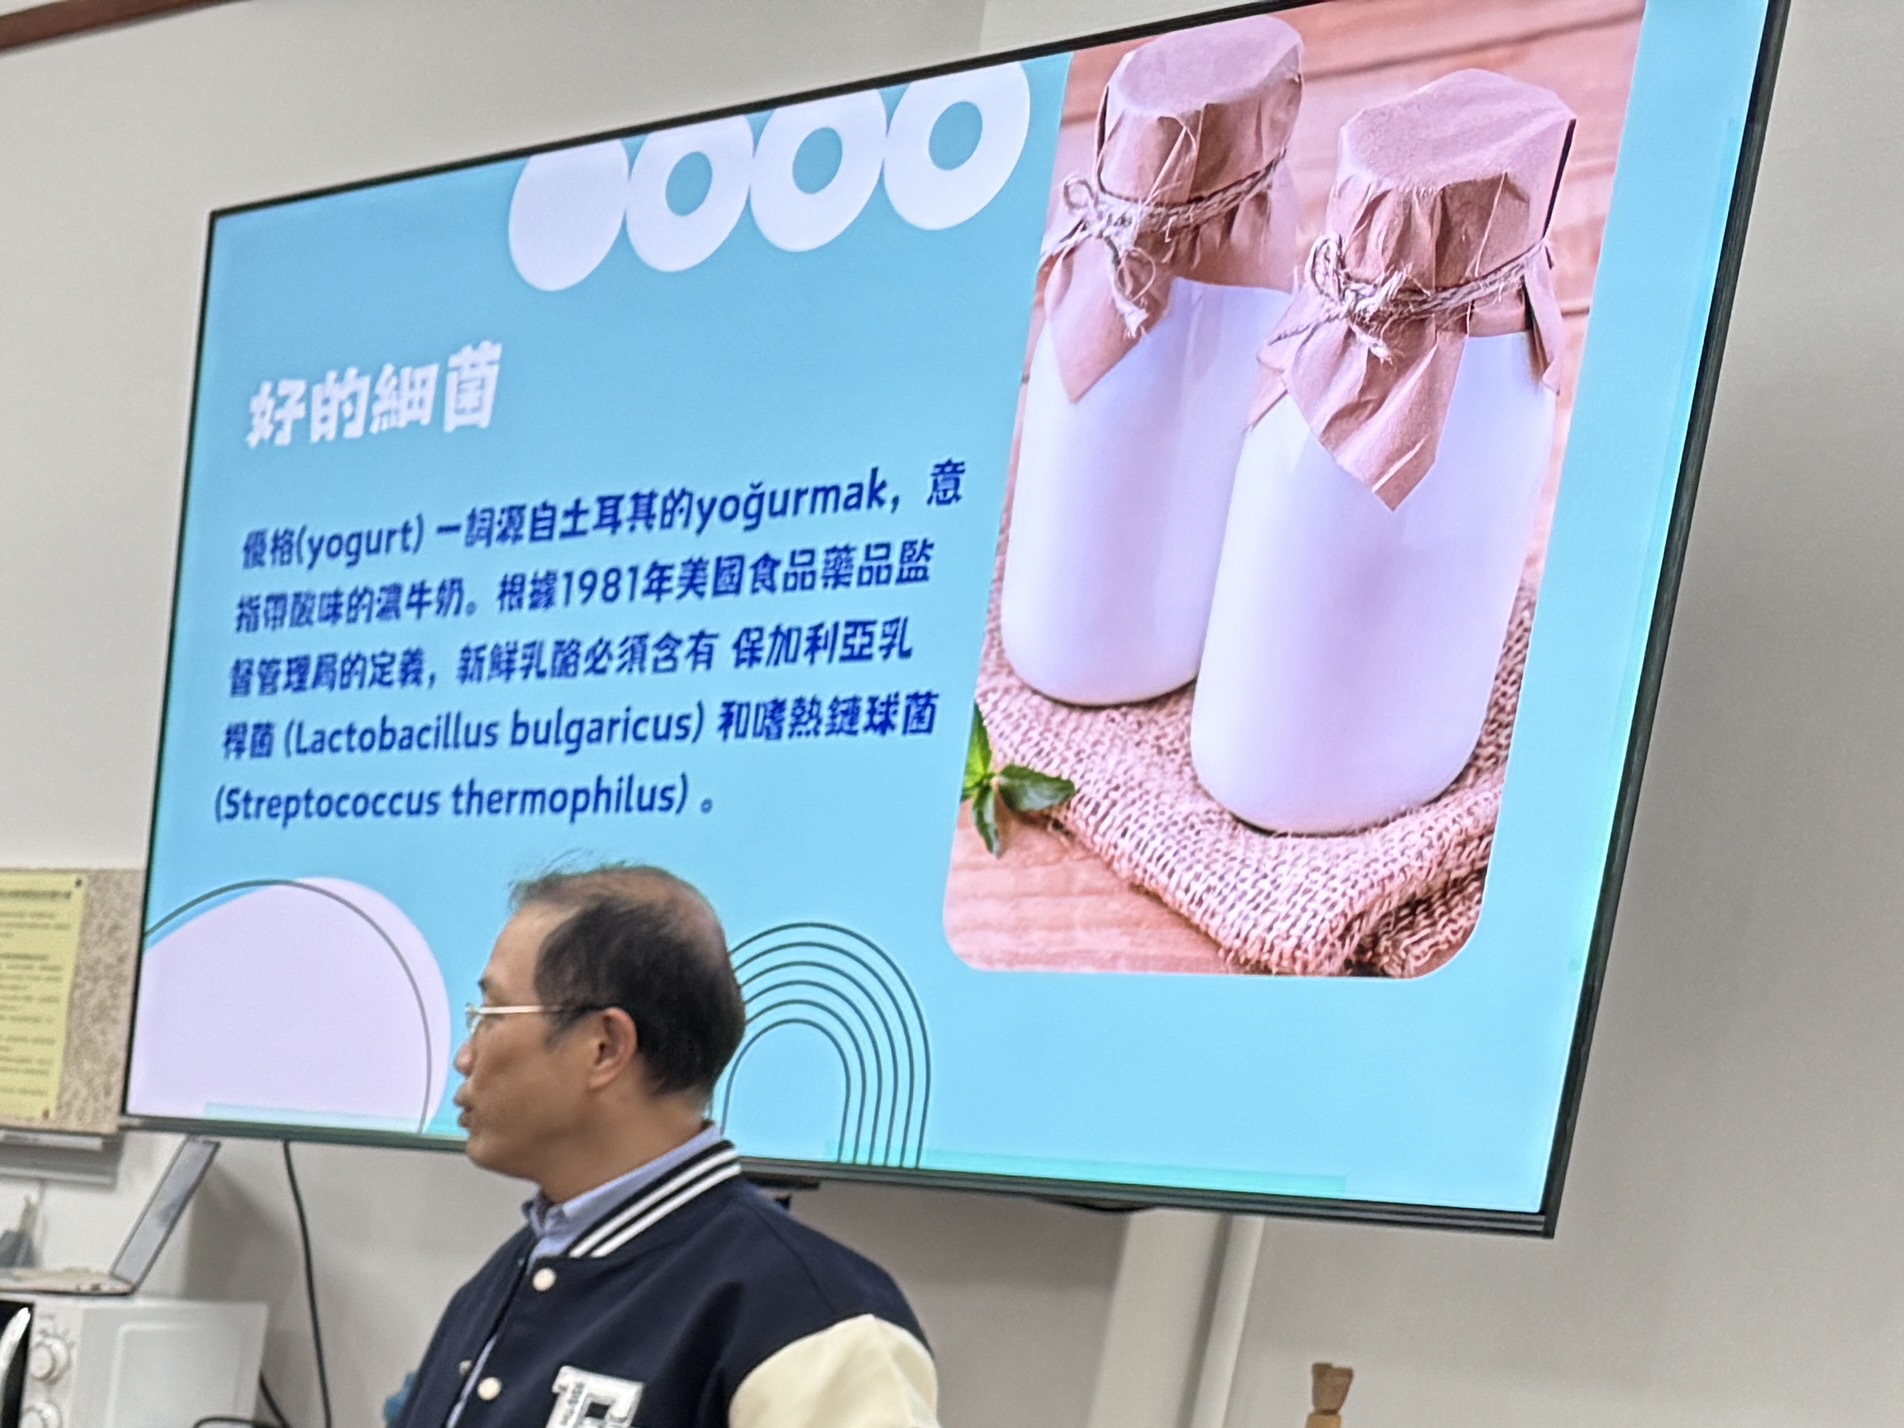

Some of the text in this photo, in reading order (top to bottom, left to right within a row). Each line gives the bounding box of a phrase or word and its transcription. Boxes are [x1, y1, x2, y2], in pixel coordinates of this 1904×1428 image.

[245, 339, 503, 448] 好的細菌
[732, 615, 914, 671] 保加利亞乳
[284, 711, 499, 759] (Lactobacillus
[511, 699, 704, 756] bulgaricus)
[214, 783, 441, 830] (Streptococcus
